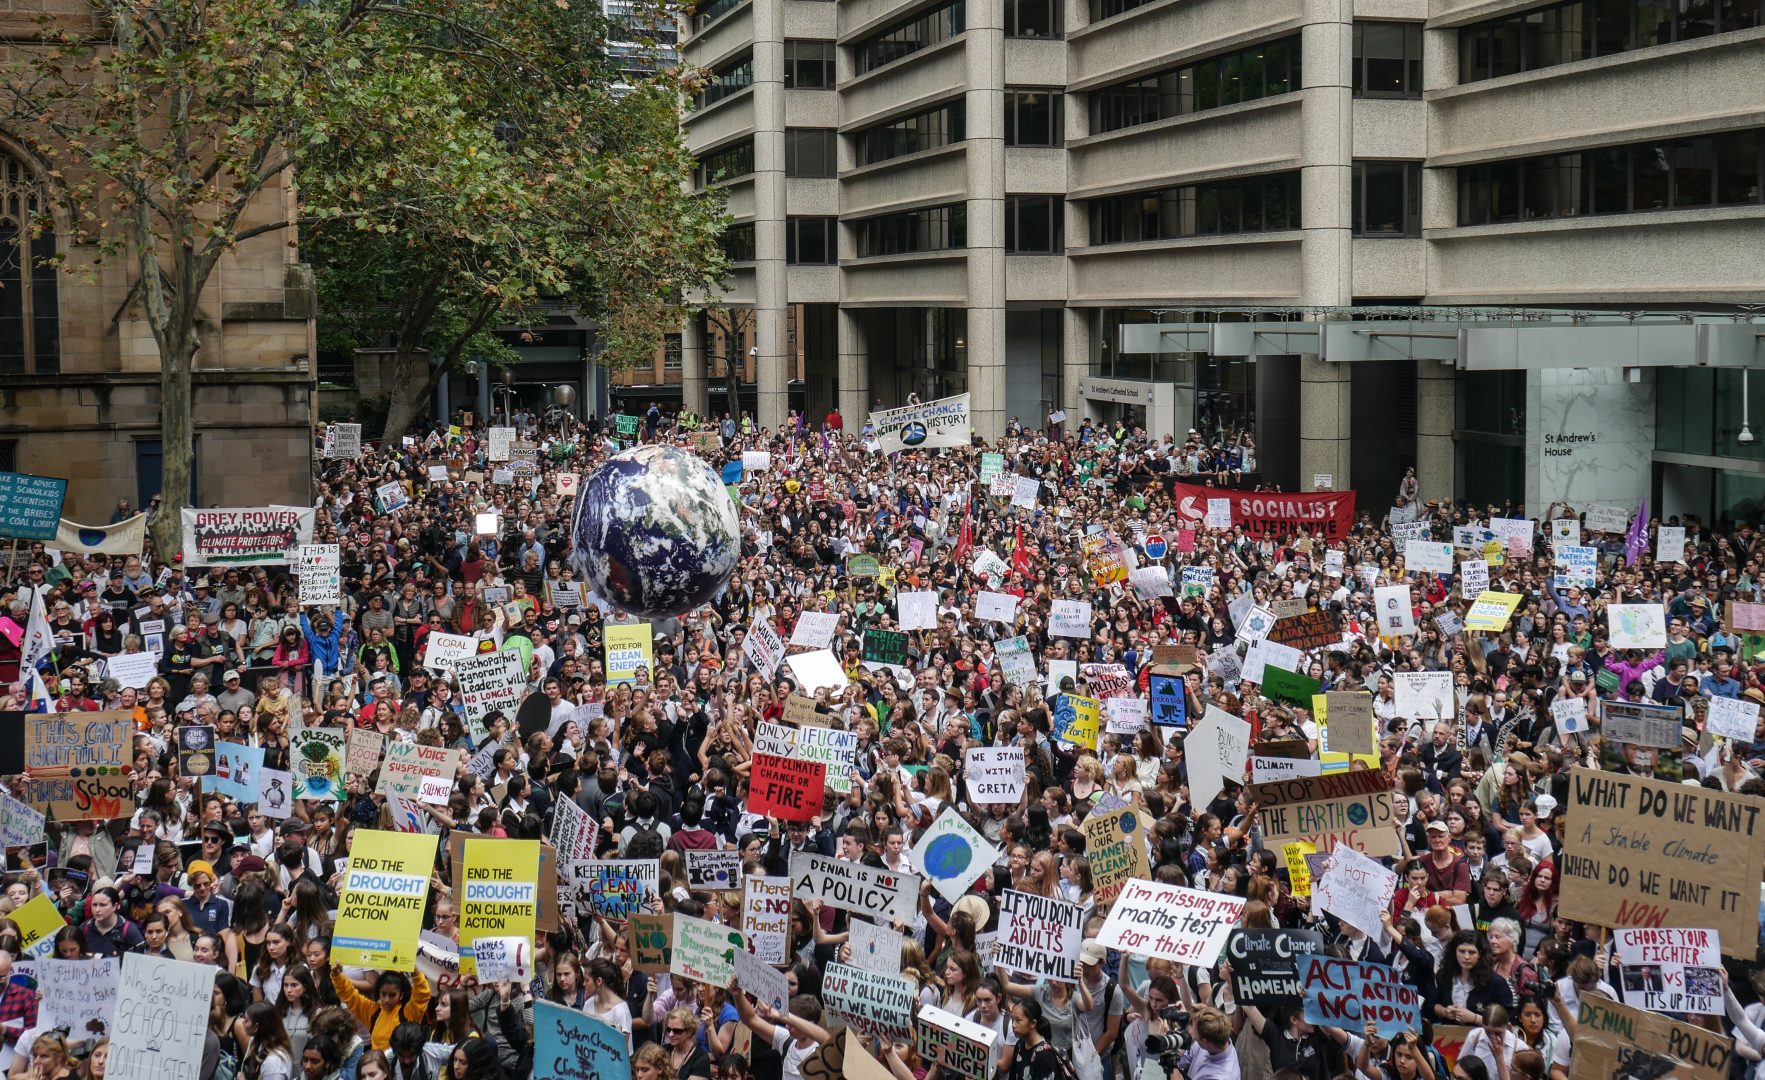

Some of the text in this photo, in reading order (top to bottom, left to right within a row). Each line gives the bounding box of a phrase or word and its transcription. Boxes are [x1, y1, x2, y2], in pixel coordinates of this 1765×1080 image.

[880, 403, 963, 425] CLIMATE CHANGE
[927, 414, 967, 428] HISTORY
[1545, 432, 1596, 443] St Andrew's
[1544, 448, 1572, 456] House
[16, 477, 57, 488] THE ADVICE
[16, 486, 60, 498] SCHOOLKIDS
[24, 508, 54, 518] BRIBES
[1240, 499, 1338, 518] SOCIALIST
[10, 516, 30, 526] COAL
[197, 512, 298, 526] GREY POWER
[202, 536, 236, 548] CLIMATE
[1475, 604, 1504, 612] CLEAN
[438, 638, 467, 649] CORAL
[444, 650, 461, 658] NOT
[610, 651, 641, 660] CLEAN
[459, 665, 508, 684] Ignorant
[462, 678, 504, 694] Leaders
[1089, 677, 1128, 695] POLITICS
[464, 688, 513, 704] NO LONGER
[468, 706, 478, 716] Be
[1717, 698, 1752, 715] PLEASE
[32, 720, 130, 744] THIS CAN'T
[972, 752, 1024, 762] WE STAND
[1256, 759, 1294, 770] CLIMATE
[757, 755, 820, 776] STOP CLIMATE
[985, 768, 1011, 776] WITH
[760, 769, 808, 787] CHANGE OR
[27, 779, 134, 810] FINISH School
[978, 783, 1016, 794] GRETA
[1576, 775, 1760, 836] WHAT DO WE WANT
[1088, 816, 1118, 838] KEEP
[1094, 836, 1113, 848] OUR
[352, 858, 404, 872] END THE
[468, 868, 512, 879] END THE
[811, 862, 899, 888] DENIAL IS NOT
[1114, 867, 1130, 880] NOT
[349, 874, 424, 892] DROUGHT
[589, 879, 637, 894] CLEAN
[750, 880, 790, 896] There
[1565, 854, 1740, 912] WHEN DO WE WANT IT
[468, 886, 532, 899] DROUGHT
[346, 893, 421, 910] ON CLIMATE
[1126, 886, 1242, 924] i'm missing my
[343, 906, 388, 921] ACTION
[466, 904, 532, 916] ON CLIMATE
[1615, 900, 1670, 928] NOW
[465, 918, 505, 928] ACTION
[746, 917, 786, 932] Planet
[1010, 914, 1064, 937] ACT LIKE
[1118, 906, 1224, 937] maths test
[1009, 928, 1063, 952] ADULTS
[1624, 930, 1709, 948] CHOOSE YOUR
[476, 952, 506, 960] RISE UP
[827, 964, 907, 990] EARTH WILL SURVIVE
[824, 976, 912, 1008] OUR POLLUTION
[1670, 994, 1684, 1010] UP
[1686, 994, 1696, 1010] TO
[1578, 1001, 1635, 1040] DENIAL
[920, 1024, 988, 1062] THE END
[1668, 1028, 1730, 1072] POLICY
[922, 1039, 987, 1079] IS NIGH
